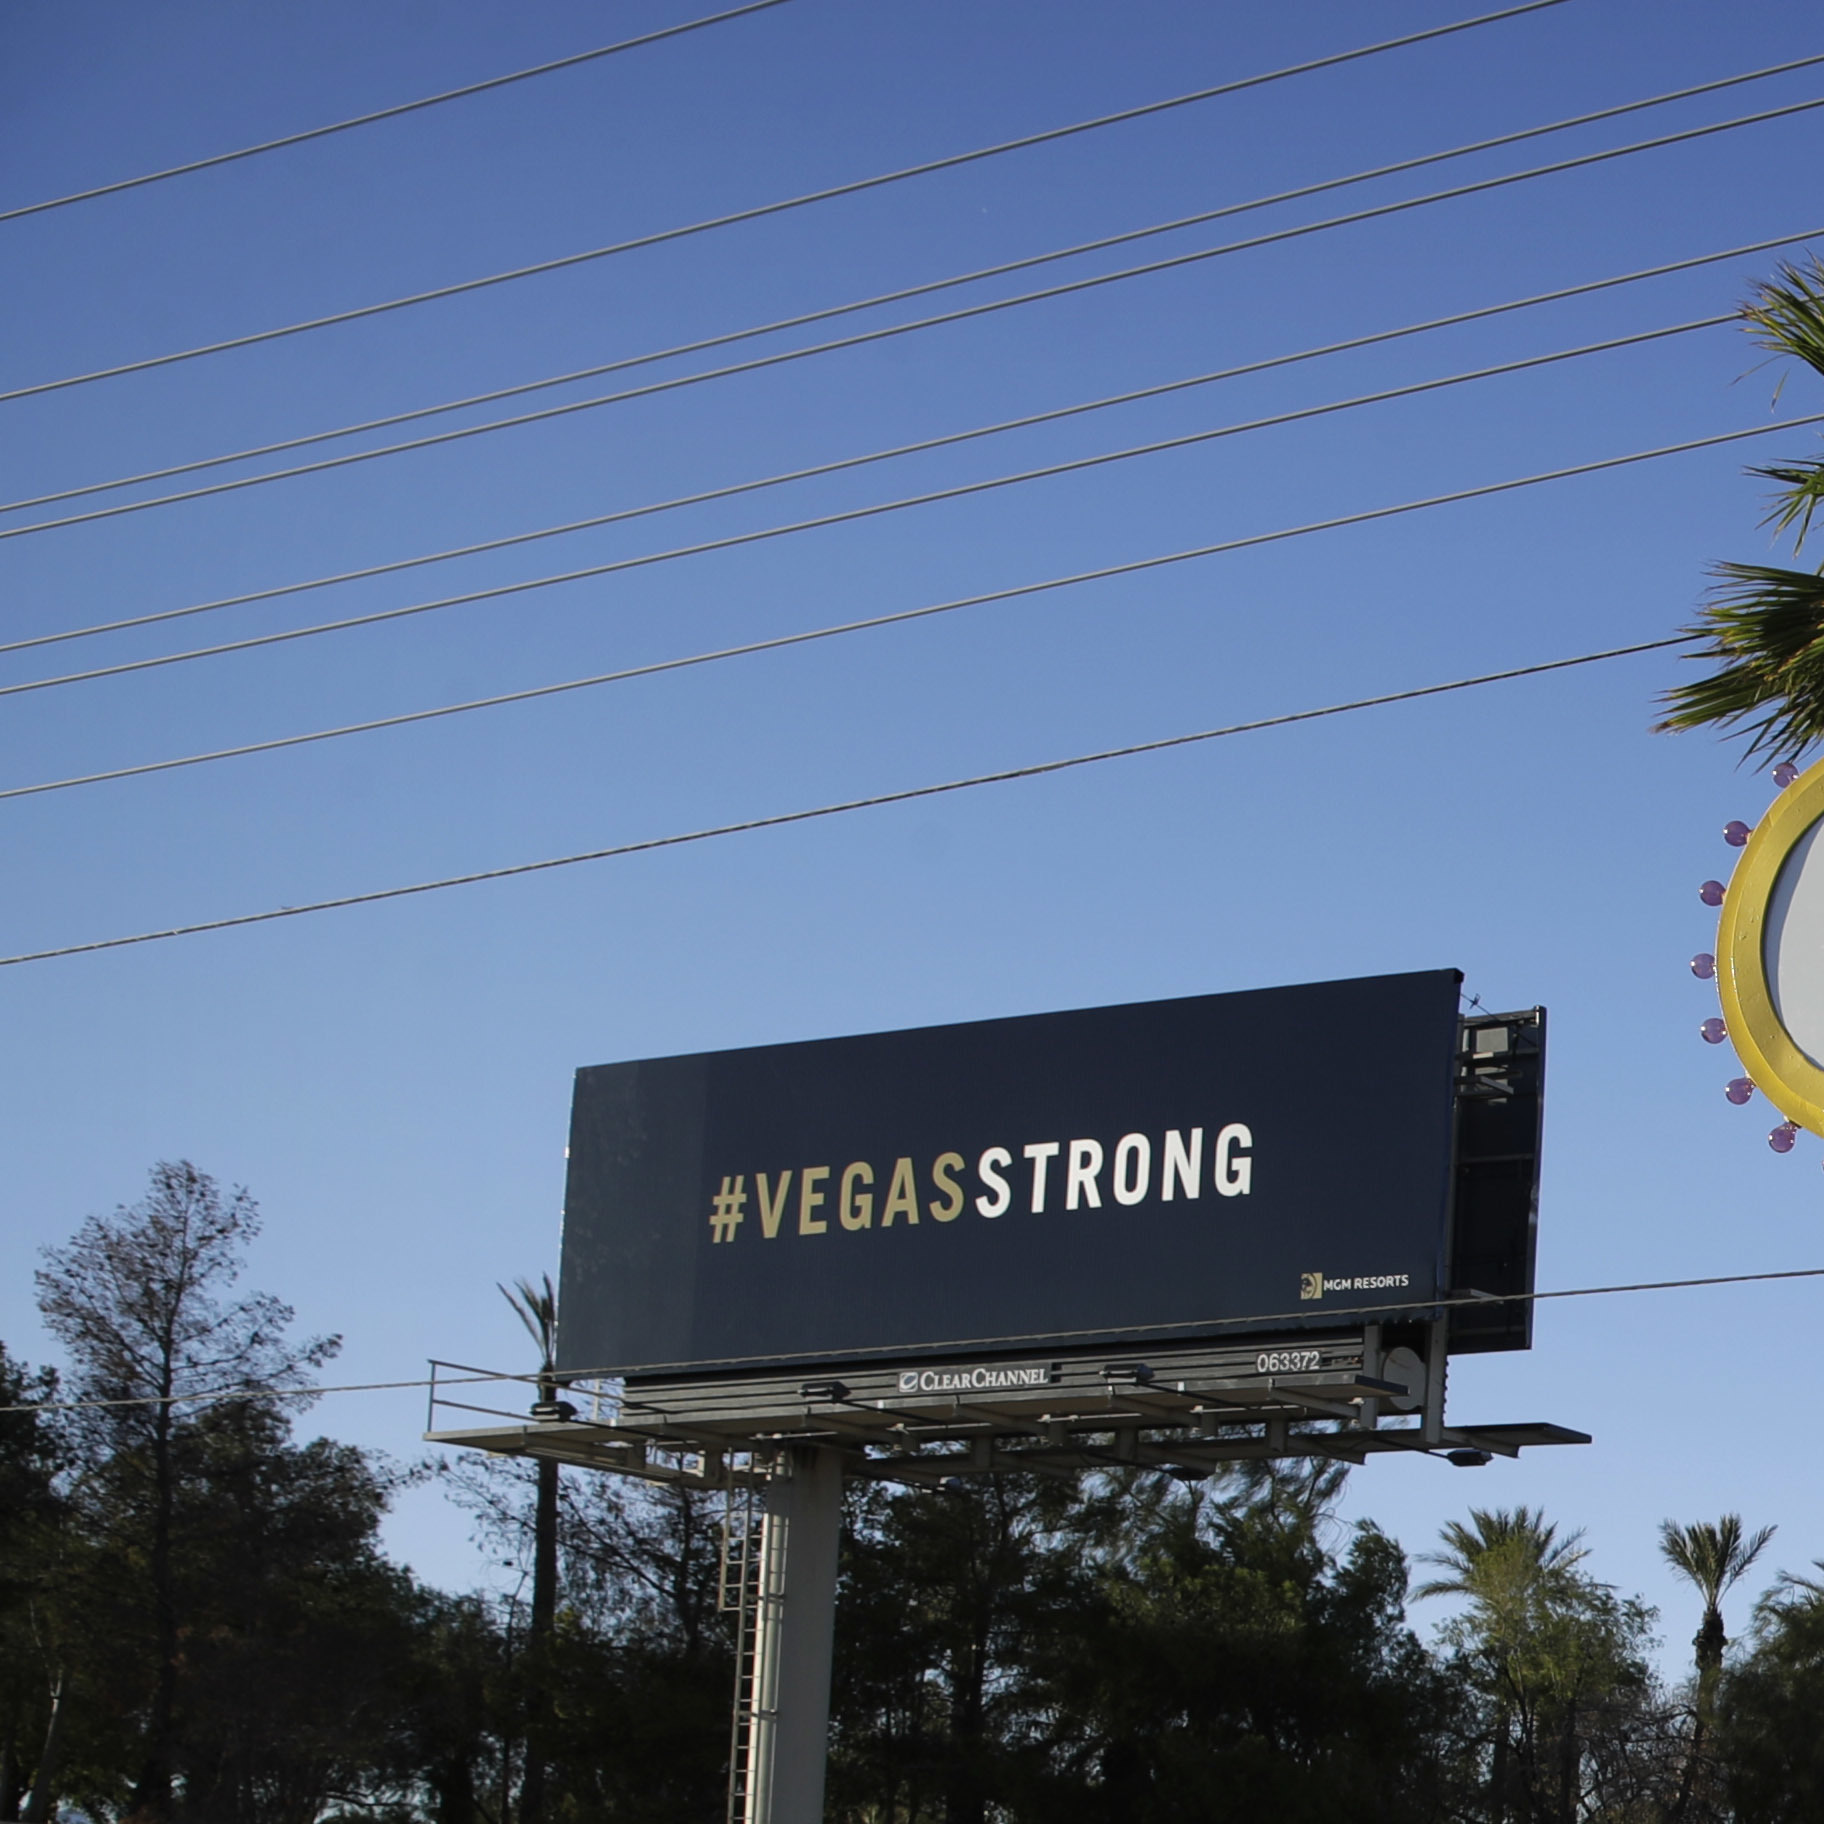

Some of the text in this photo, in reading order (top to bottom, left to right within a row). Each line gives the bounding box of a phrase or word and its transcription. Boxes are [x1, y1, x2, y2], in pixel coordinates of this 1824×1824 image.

[709, 1122, 1253, 1243] #VEGASSTRONG
[1323, 1273, 1410, 1292] MGM RESORTS
[1257, 1350, 1321, 1373] 063372
